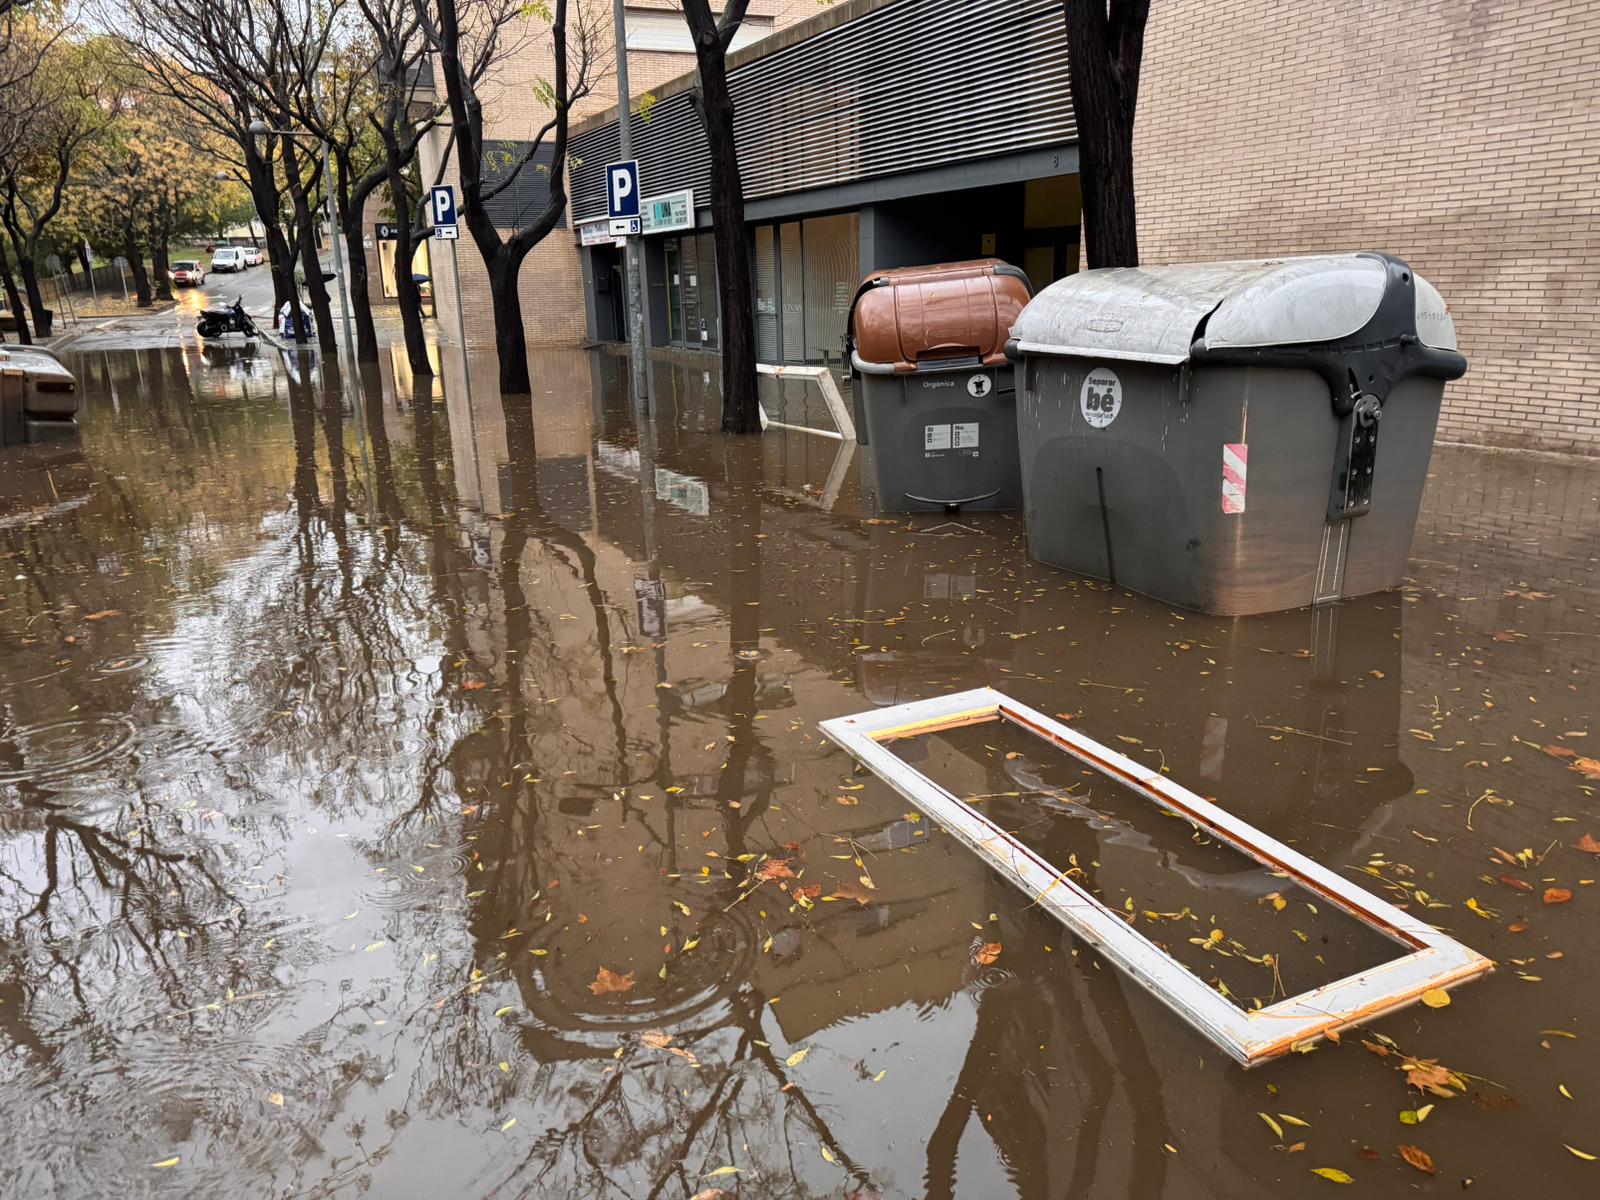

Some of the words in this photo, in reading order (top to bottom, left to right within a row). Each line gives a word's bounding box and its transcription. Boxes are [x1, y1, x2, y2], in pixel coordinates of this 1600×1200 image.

[612, 169, 632, 212] P
[435, 190, 450, 222] P
[1088, 376, 1117, 387] Separar
[1086, 386, 1115, 412] bé
